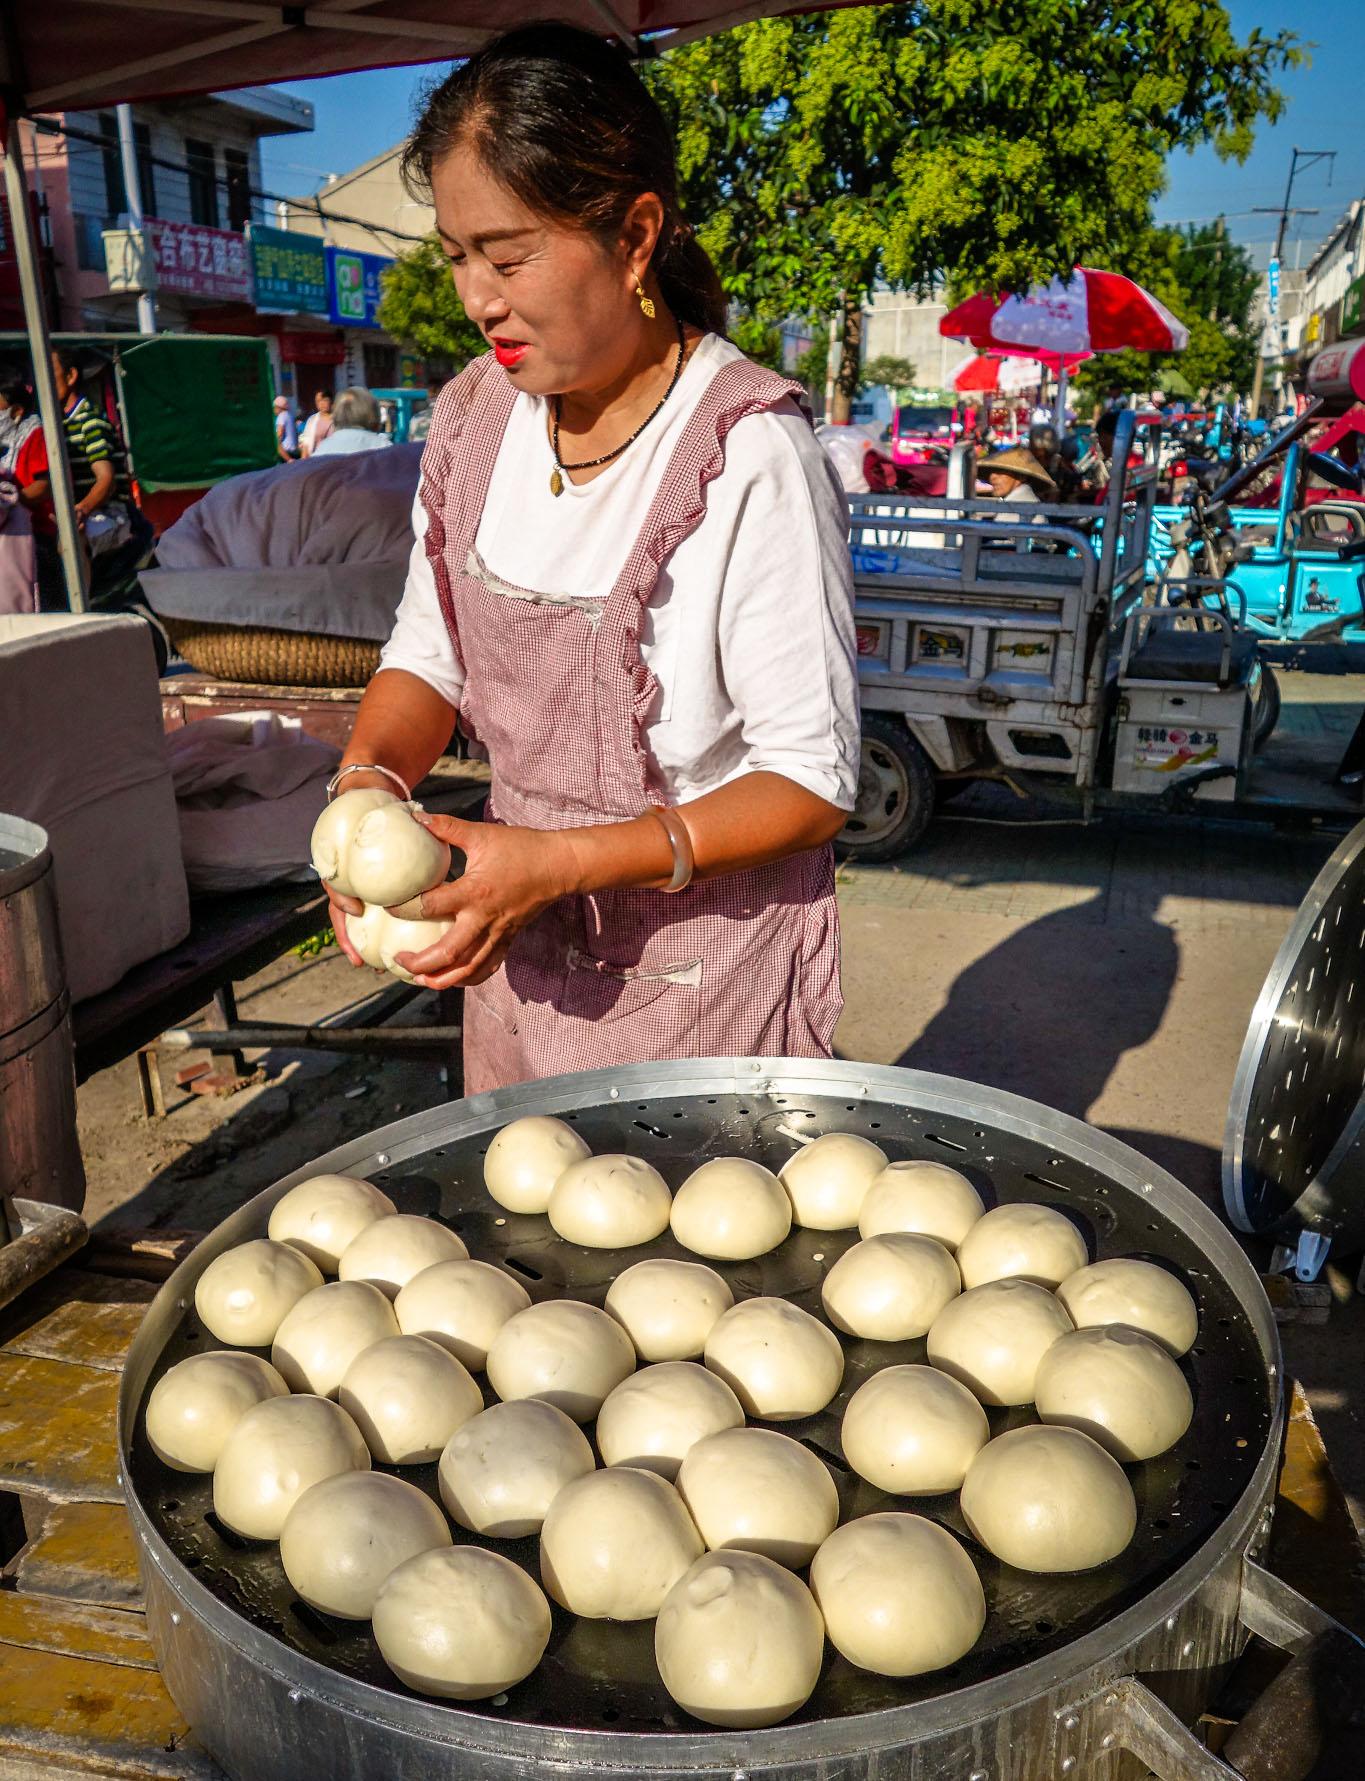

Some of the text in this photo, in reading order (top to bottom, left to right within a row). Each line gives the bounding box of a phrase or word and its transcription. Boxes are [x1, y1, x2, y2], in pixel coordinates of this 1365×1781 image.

[154, 223, 248, 277] 合布艺窗帘
[1189, 730, 1218, 747] 金马
